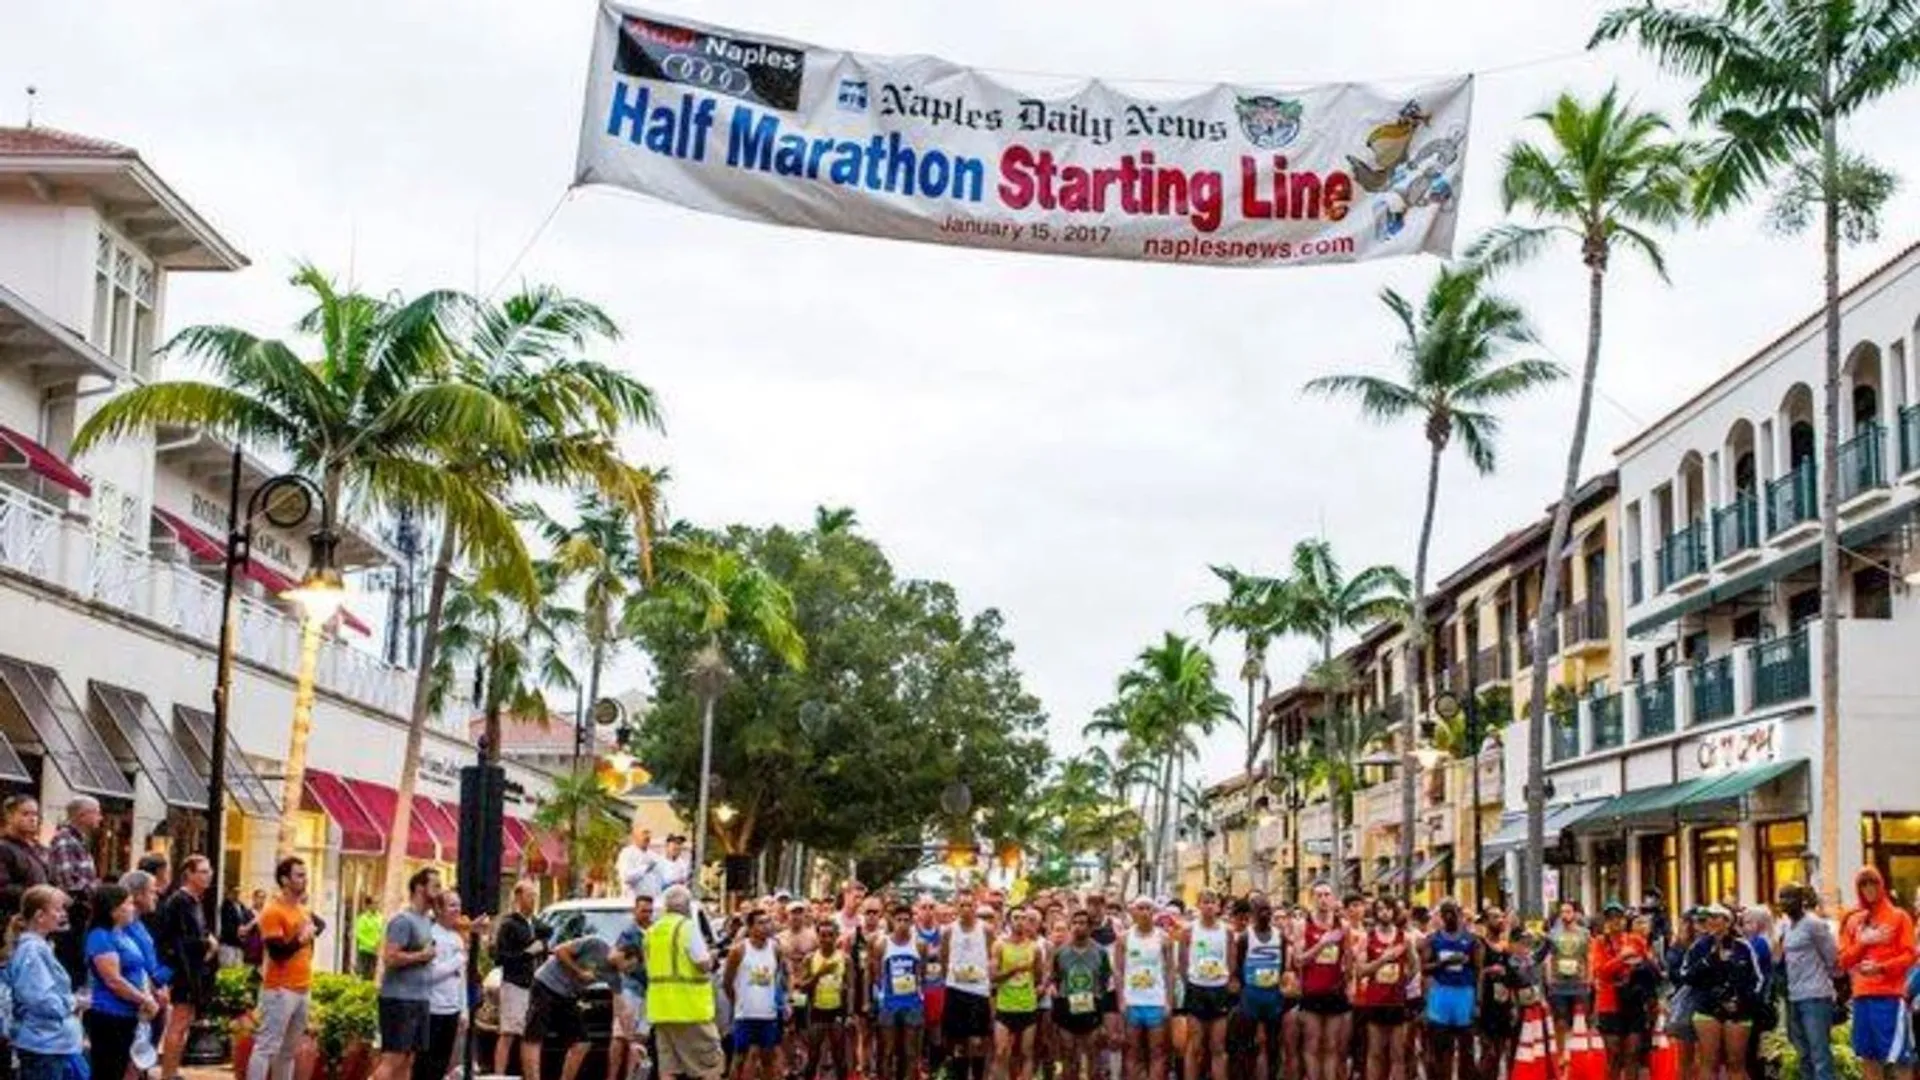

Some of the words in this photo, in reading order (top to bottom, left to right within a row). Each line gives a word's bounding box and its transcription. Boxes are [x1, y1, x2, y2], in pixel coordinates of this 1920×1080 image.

[705, 37, 797, 71] Naples
[881, 83, 1003, 131] Naples
[1017, 99, 1113, 145] Daily
[1125, 103, 1228, 142] News
[606, 80, 717, 163] Half
[726, 106, 984, 201] Marathon
[1000, 144, 1223, 232] Starting
[1240, 154, 1352, 221] Line
[940, 215, 1024, 241] January
[1030, 223, 1059, 243] 15,
[1064, 225, 1111, 243] 2017
[1142, 235, 1355, 263] naplesnews.com
